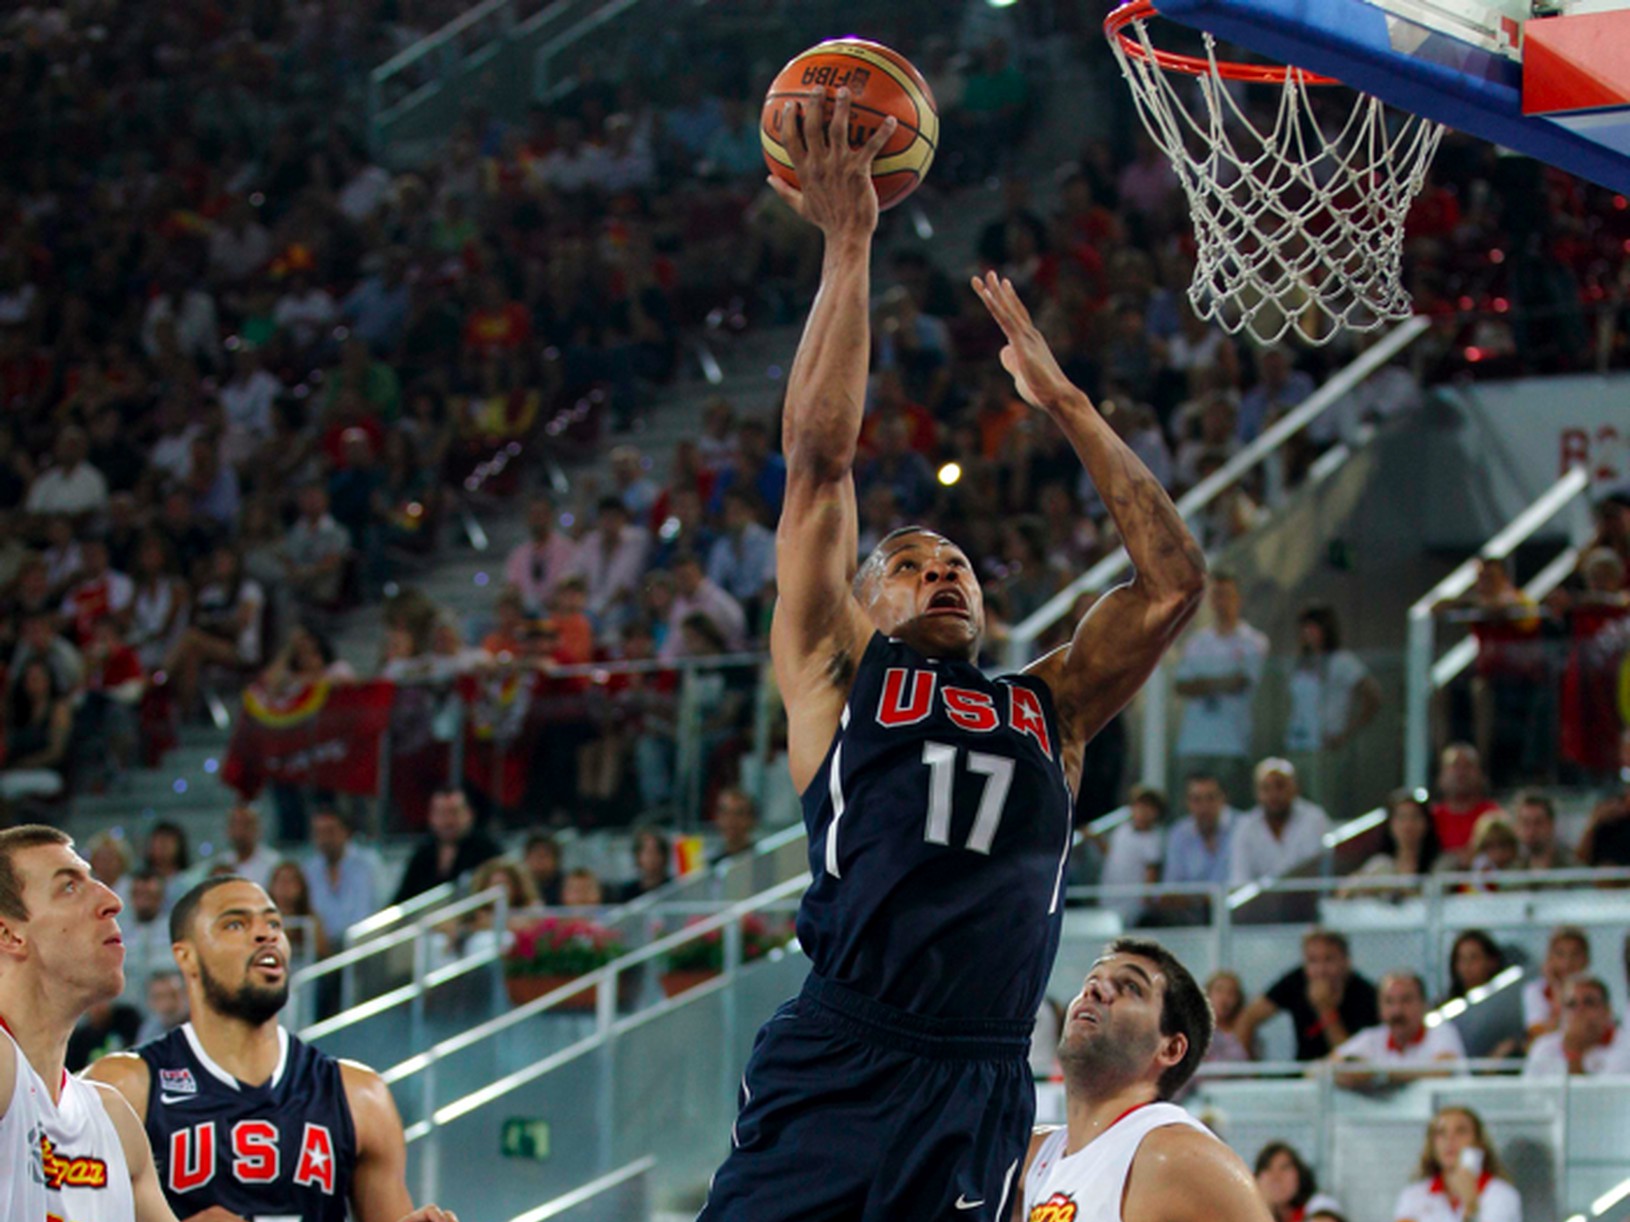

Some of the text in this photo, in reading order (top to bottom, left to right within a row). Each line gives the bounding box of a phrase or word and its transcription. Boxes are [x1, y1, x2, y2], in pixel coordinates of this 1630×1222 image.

[801, 66, 852, 88] FIBA
[875, 667, 1054, 762] USA
[921, 740, 1017, 856] 17
[168, 1119, 336, 1196] USA
